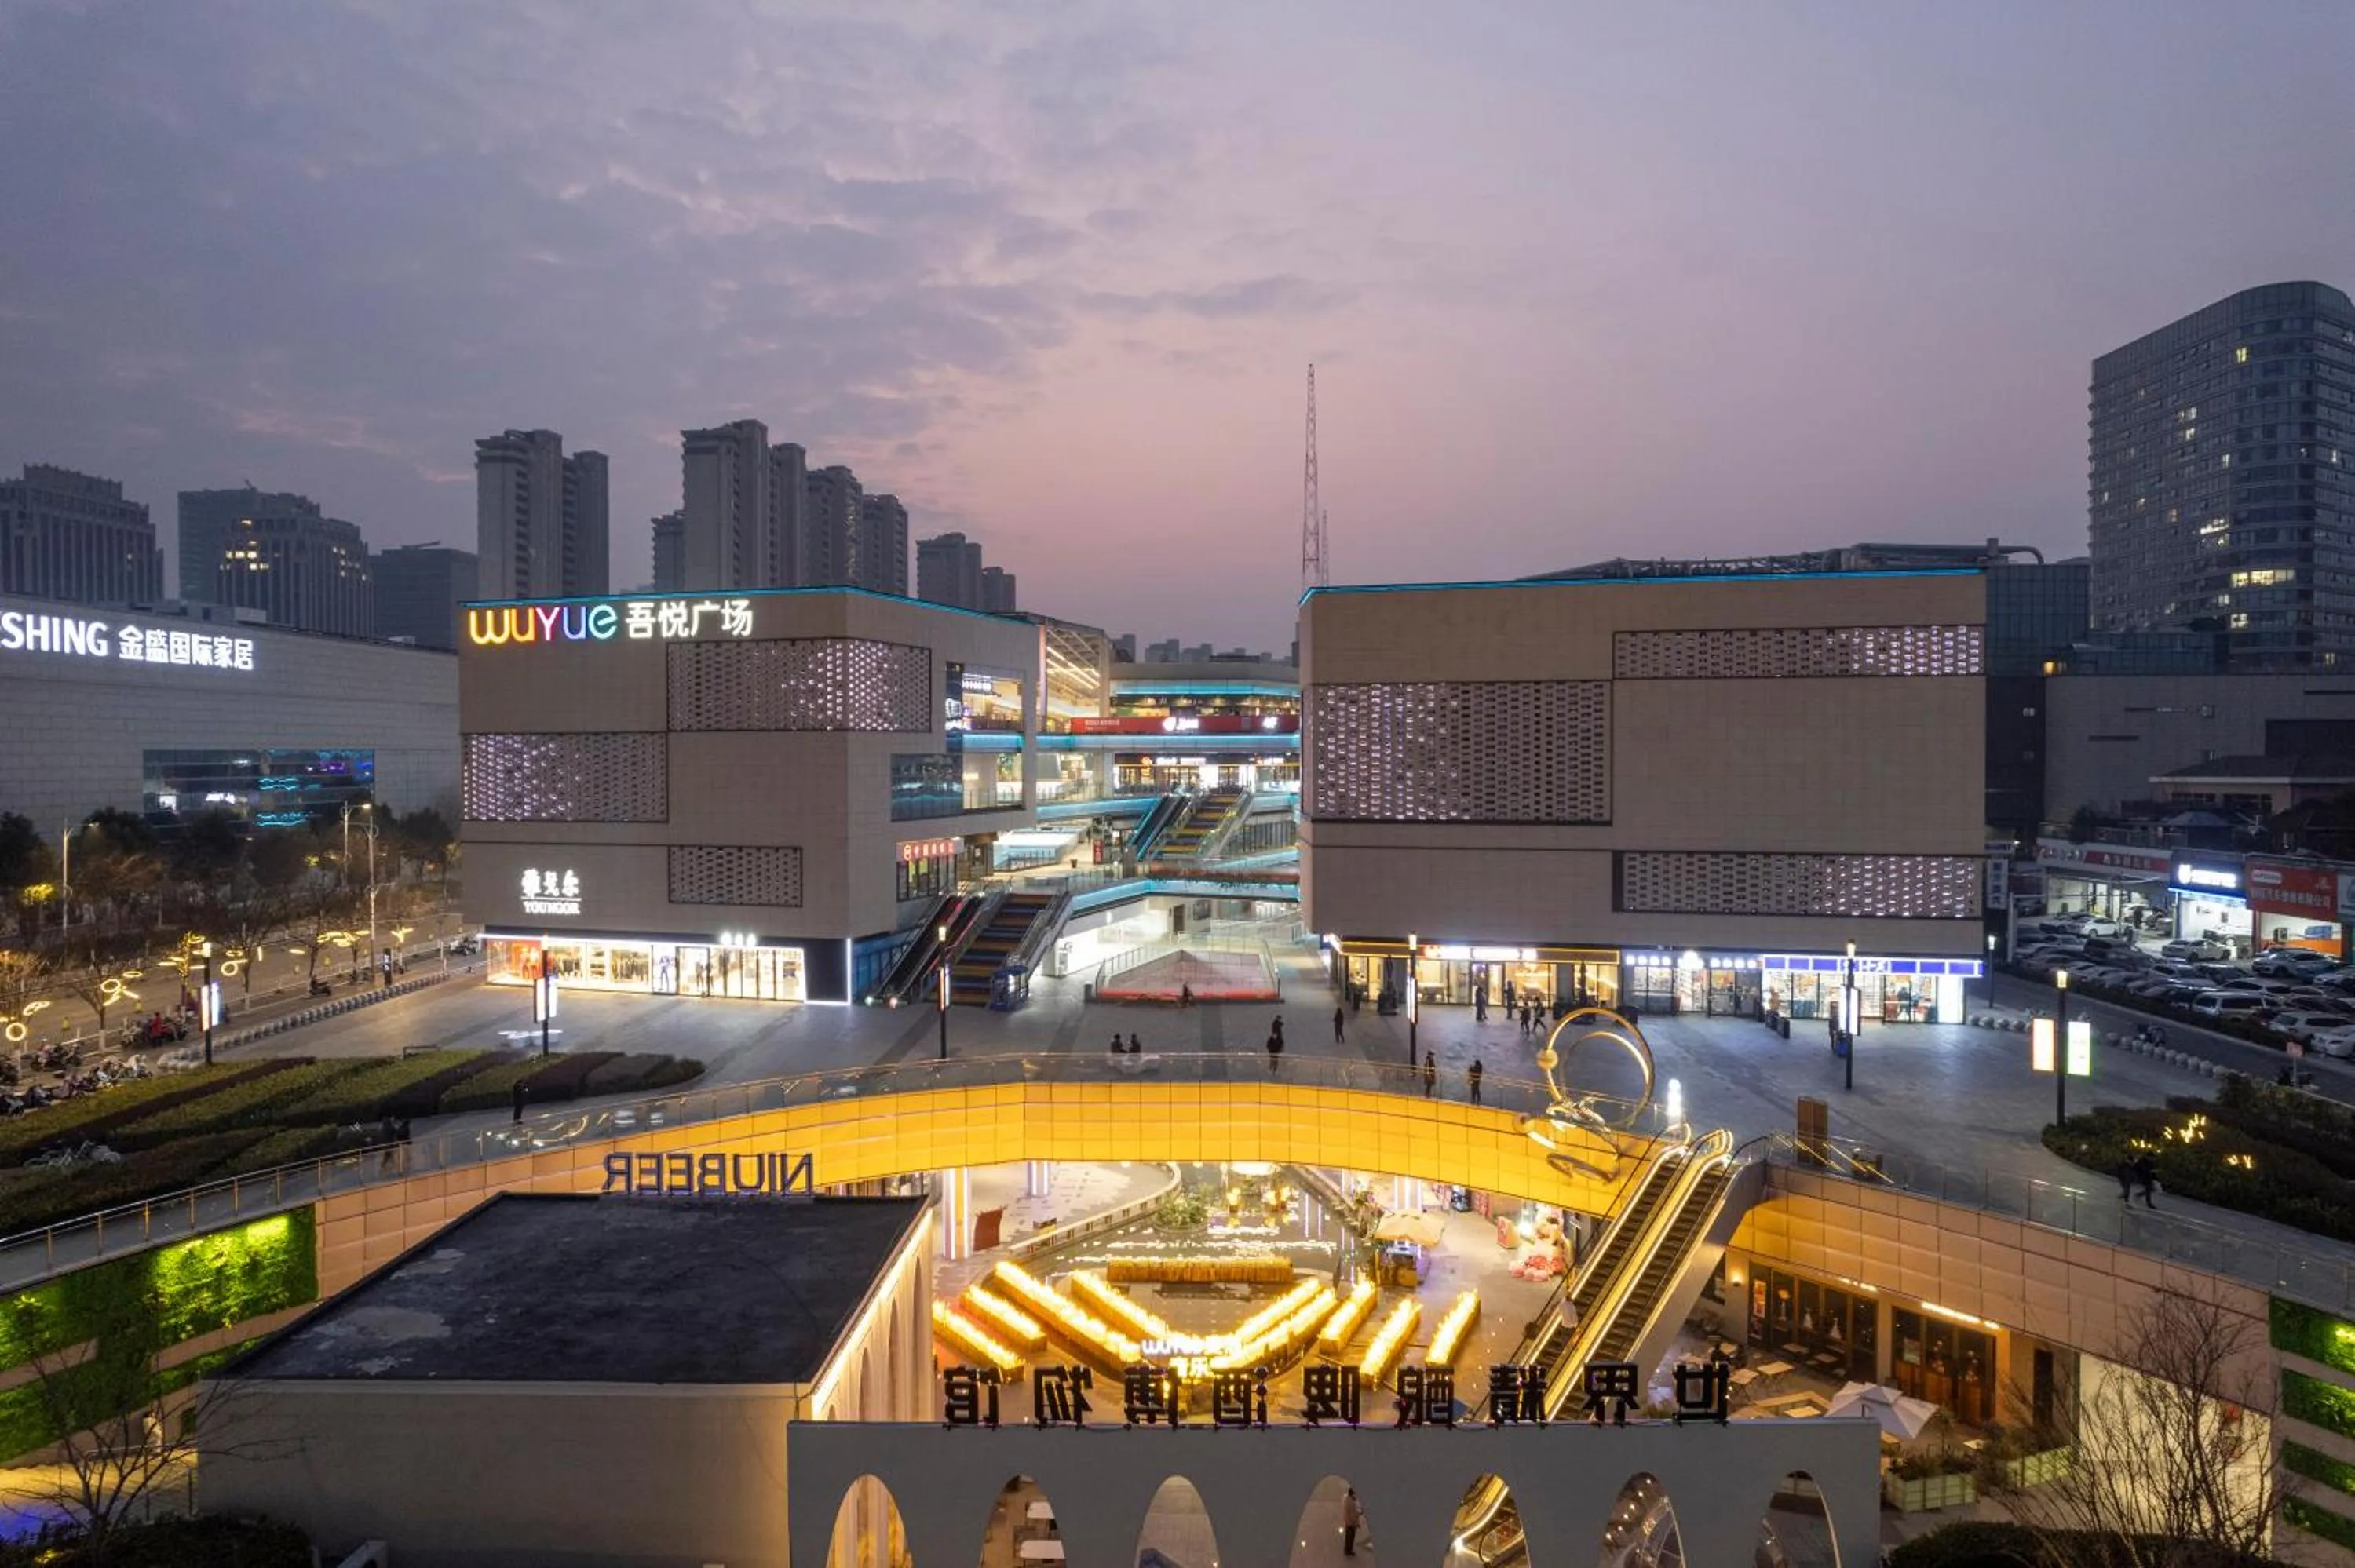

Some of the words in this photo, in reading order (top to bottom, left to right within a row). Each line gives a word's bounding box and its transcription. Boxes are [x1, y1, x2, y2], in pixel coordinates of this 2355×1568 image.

[0, 611, 109, 658] SHING
[625, 599, 754, 640] 吾悦广场
[118, 624, 254, 672] 金盛国际家居
